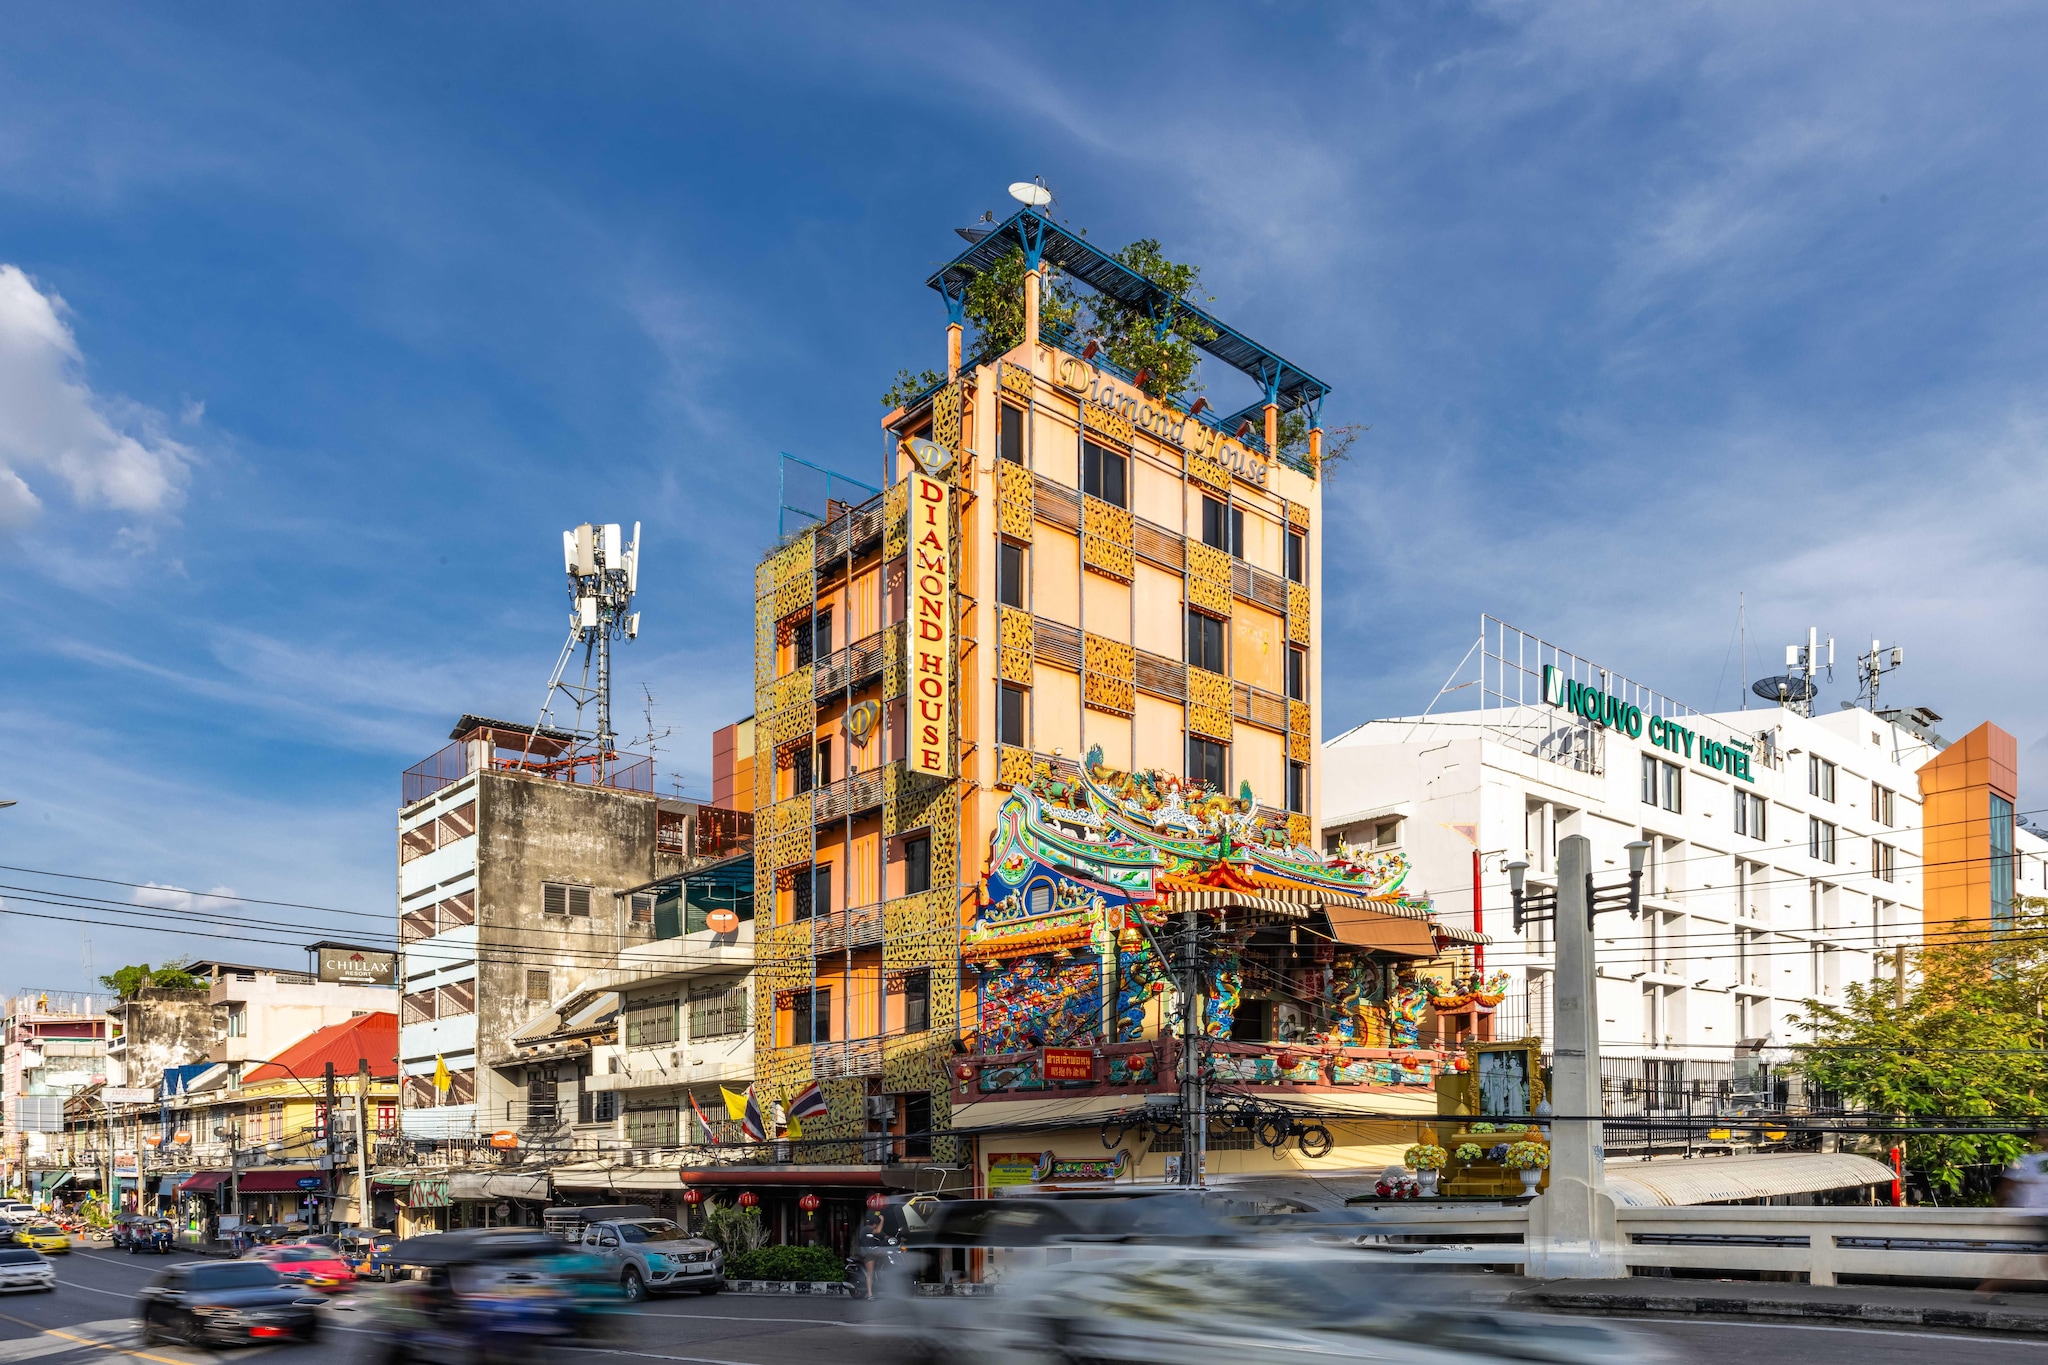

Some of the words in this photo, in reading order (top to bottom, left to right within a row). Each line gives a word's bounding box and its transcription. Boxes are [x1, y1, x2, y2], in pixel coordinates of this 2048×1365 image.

[1060, 357, 1185, 444] Diamond
[1194, 424, 1268, 483] House
[917, 479, 946, 642] DIAMOND
[919, 652, 943, 771] HOUSE
[1568, 679, 1642, 738] NOUVO
[1651, 715, 1695, 759] CITY
[1700, 735, 1755, 783] HOTEL
[326, 960, 389, 972] CHILLAX
